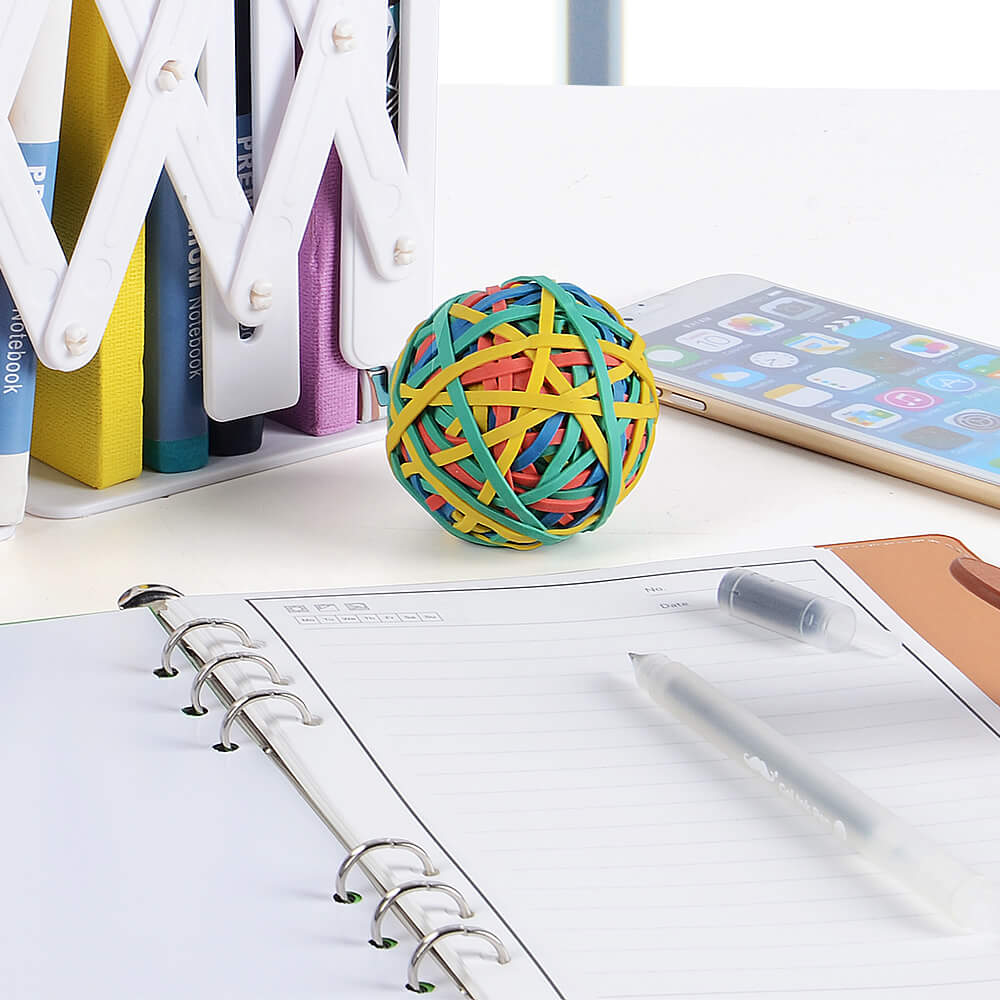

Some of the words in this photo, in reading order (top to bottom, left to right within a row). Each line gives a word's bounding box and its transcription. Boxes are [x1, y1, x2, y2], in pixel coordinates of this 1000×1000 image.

[237, 135, 252, 199] PRE
[188, 297, 202, 380] Notebook
[659, 601, 689, 609] Date
